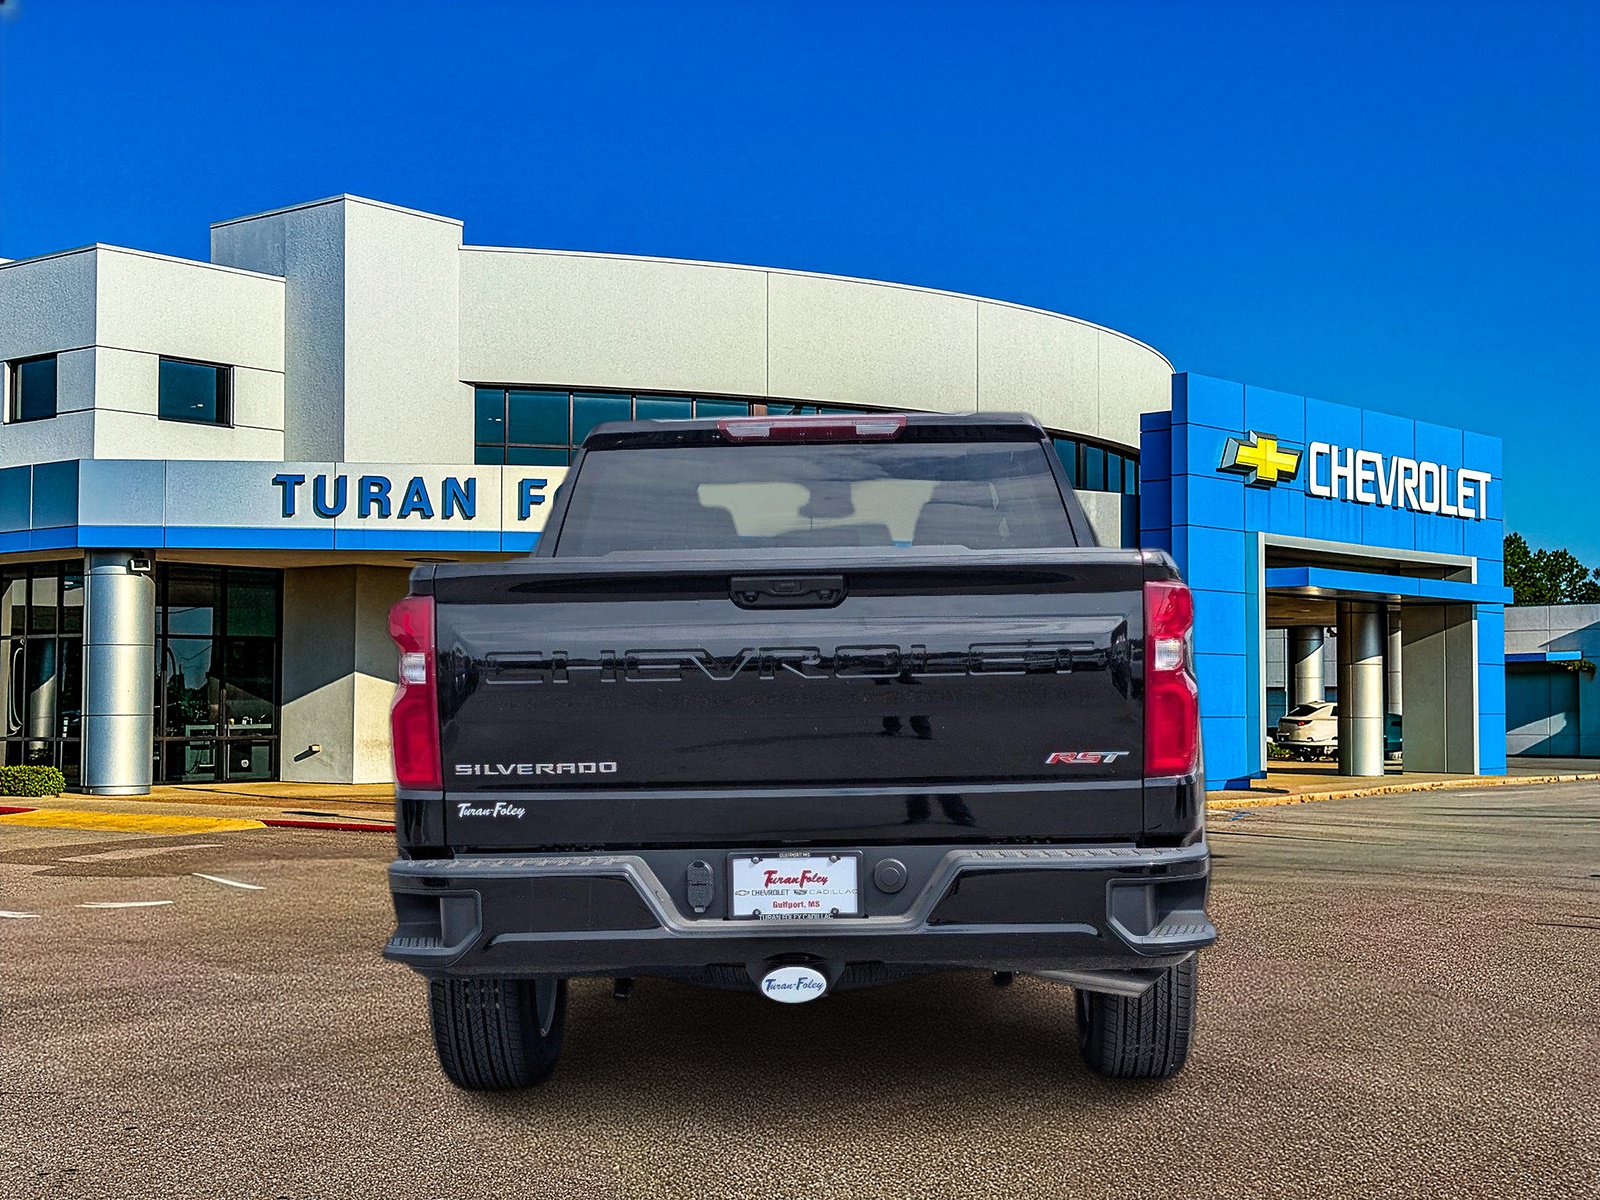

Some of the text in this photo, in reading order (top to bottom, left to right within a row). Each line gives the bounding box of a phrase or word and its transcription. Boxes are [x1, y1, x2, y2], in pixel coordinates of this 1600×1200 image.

[1307, 441, 1492, 521] CHEVROLET
[272, 473, 564, 521] TURAN F
[485, 640, 1095, 685] CHEVROLET
[1045, 751, 1130, 764] RST
[454, 761, 618, 776] SILVERADO
[457, 802, 526, 819] Turan-Foley
[772, 901, 806, 909] Gulfport,
[765, 976, 825, 992] Turan-Foley
